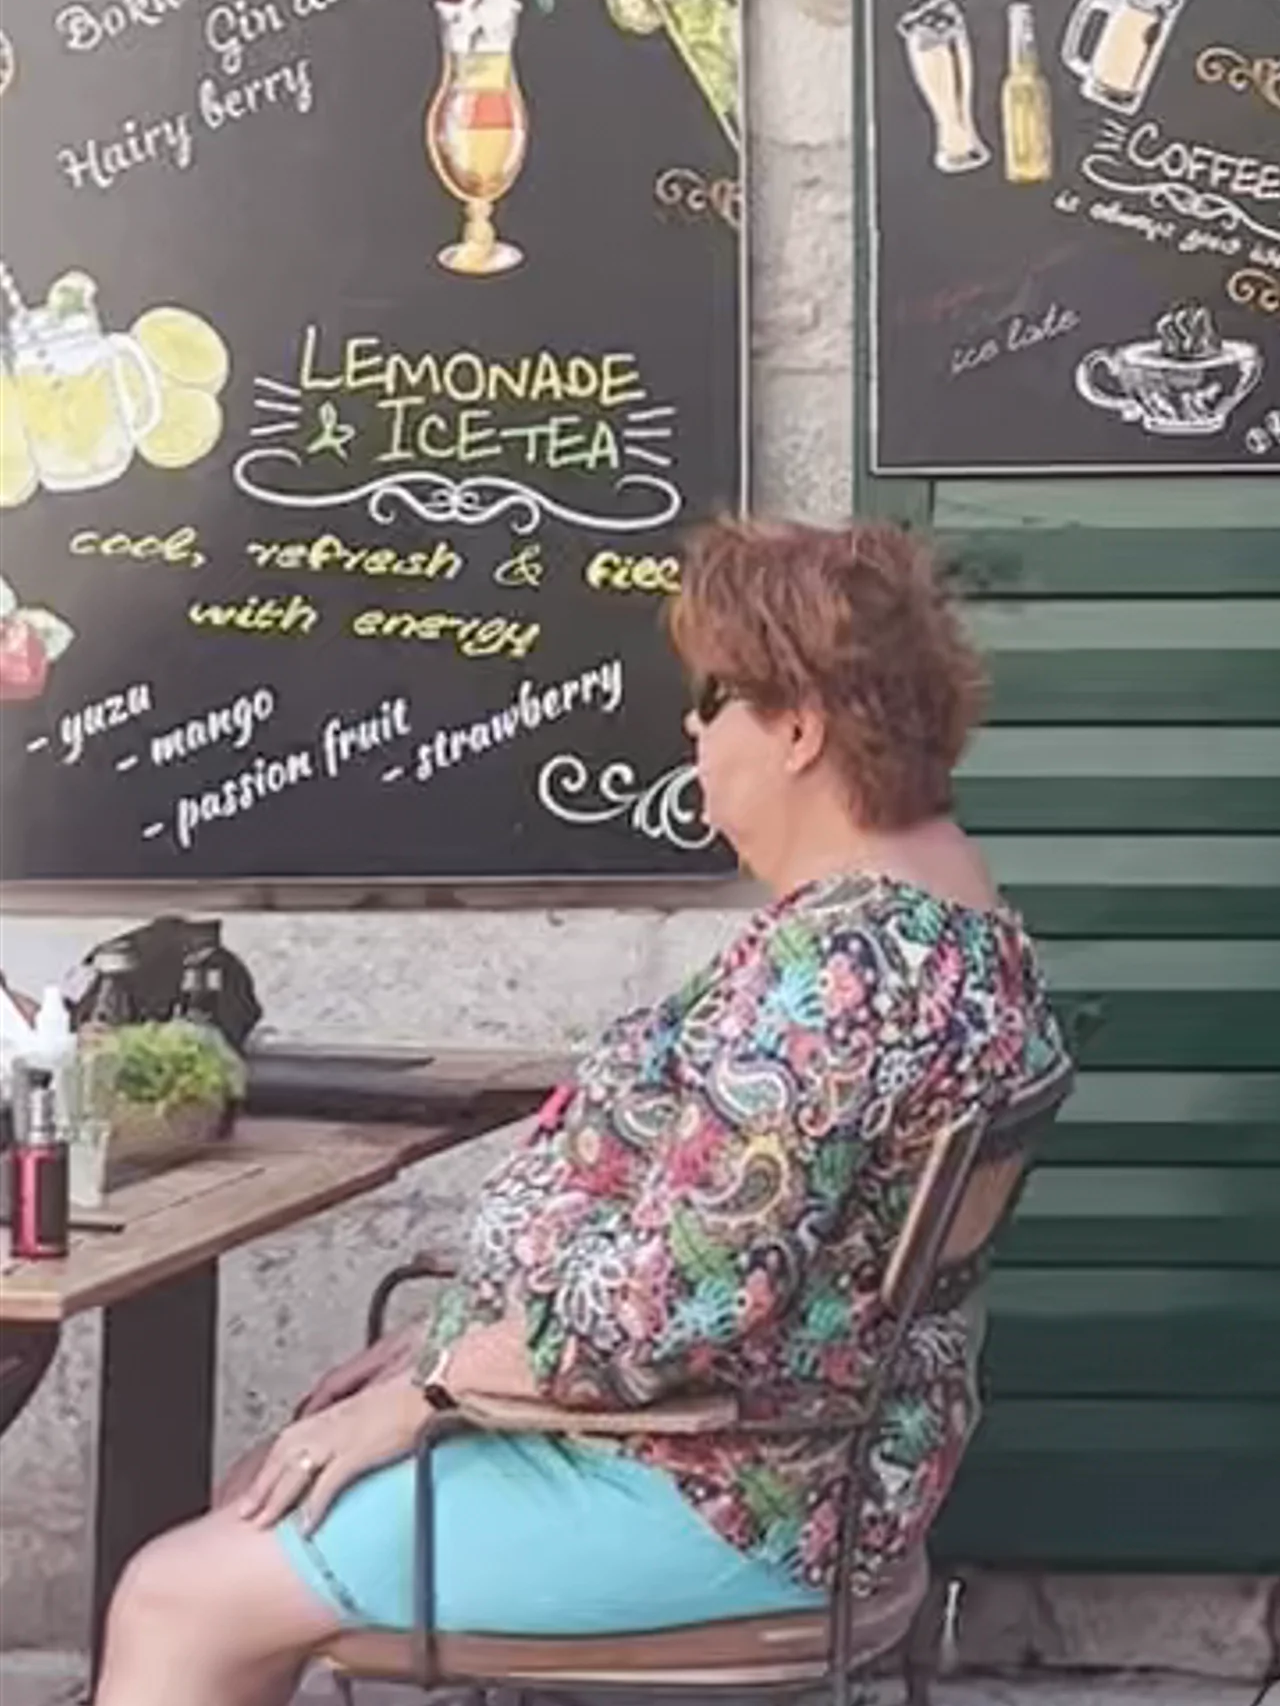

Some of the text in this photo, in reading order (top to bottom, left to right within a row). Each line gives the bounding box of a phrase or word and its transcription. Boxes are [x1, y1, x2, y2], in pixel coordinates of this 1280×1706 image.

[56, 61, 314, 189] Hairy berry
[301, 326, 646, 404] LEMONADE
[247, 534, 465, 579] refresh
[495, 545, 543, 586] &
[190, 596, 542, 658] with energy
[60, 685, 153, 764] yuzu
[150, 688, 275, 767] mango
[416, 659, 624, 782] strawberry
[176, 742, 313, 847] passion
[323, 697, 412, 778] fruit
